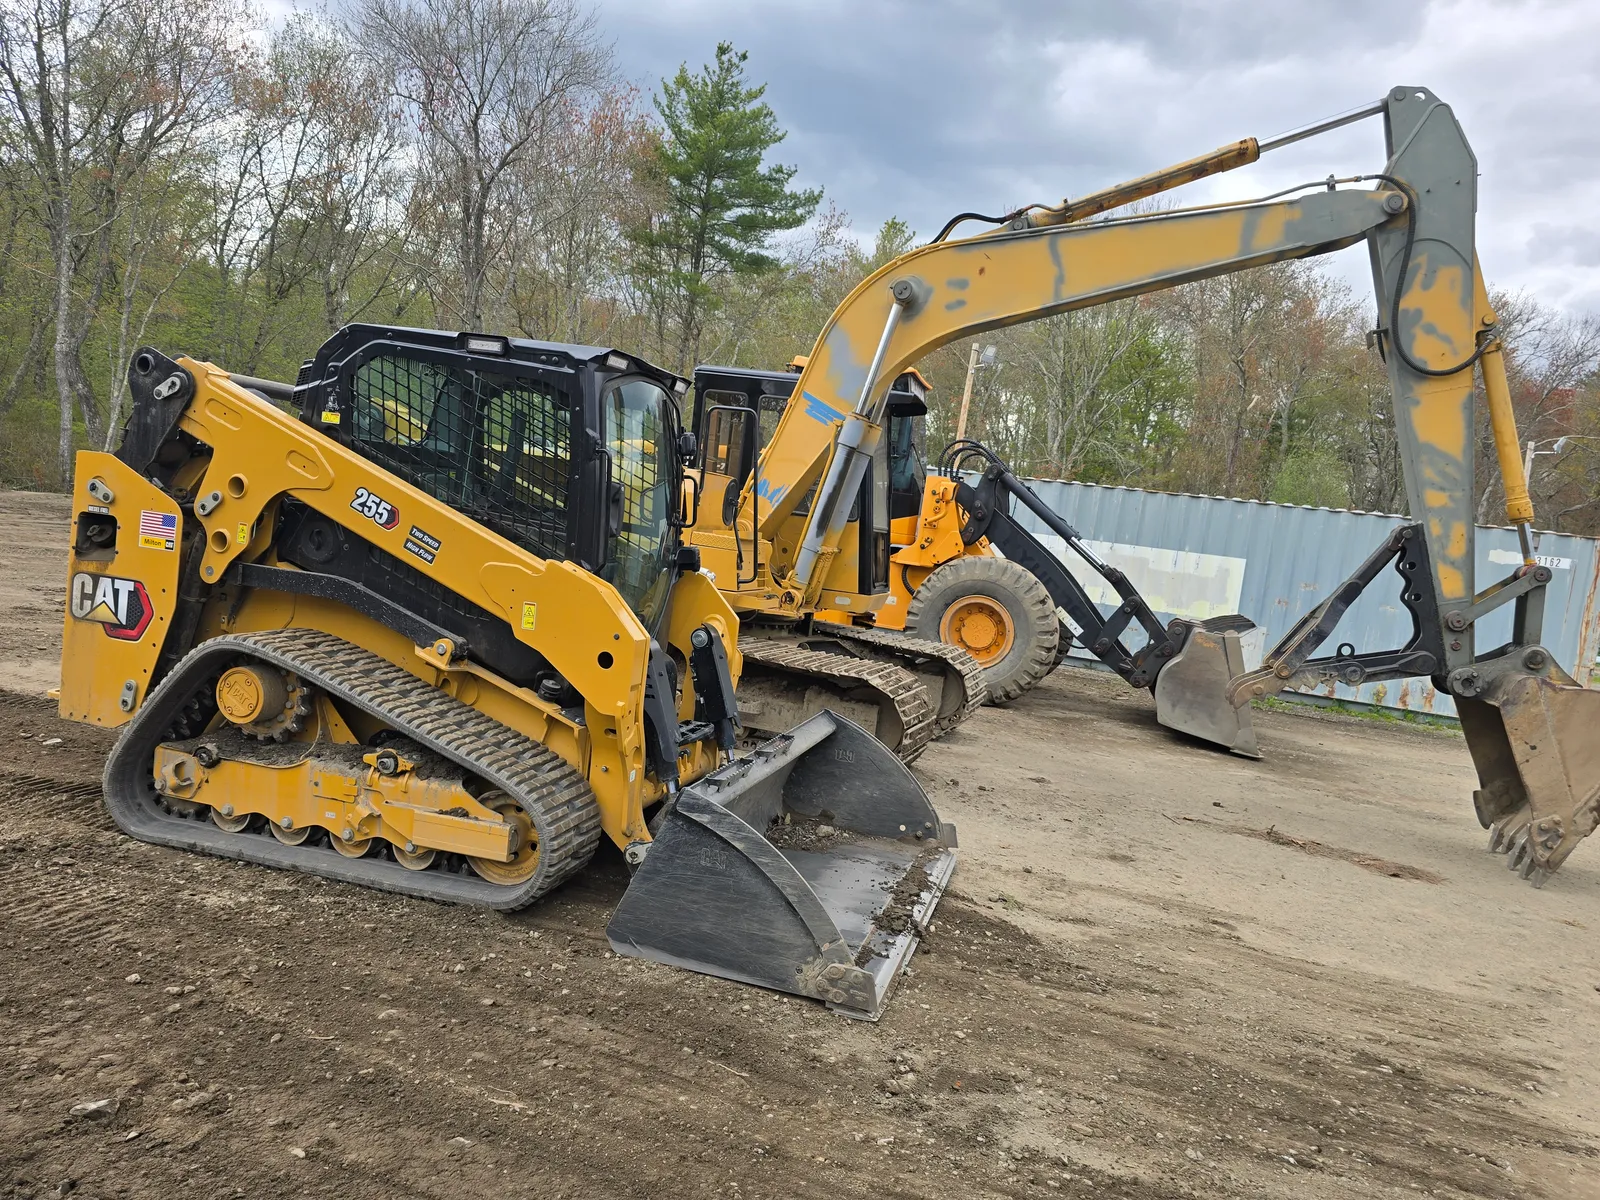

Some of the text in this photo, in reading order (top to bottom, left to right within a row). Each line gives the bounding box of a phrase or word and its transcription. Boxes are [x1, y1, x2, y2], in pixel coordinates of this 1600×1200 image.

[351, 488, 392, 524] 255
[144, 538, 162, 546] Milton
[1536, 556, 1562, 568] 3162
[72, 573, 135, 625] CAT
